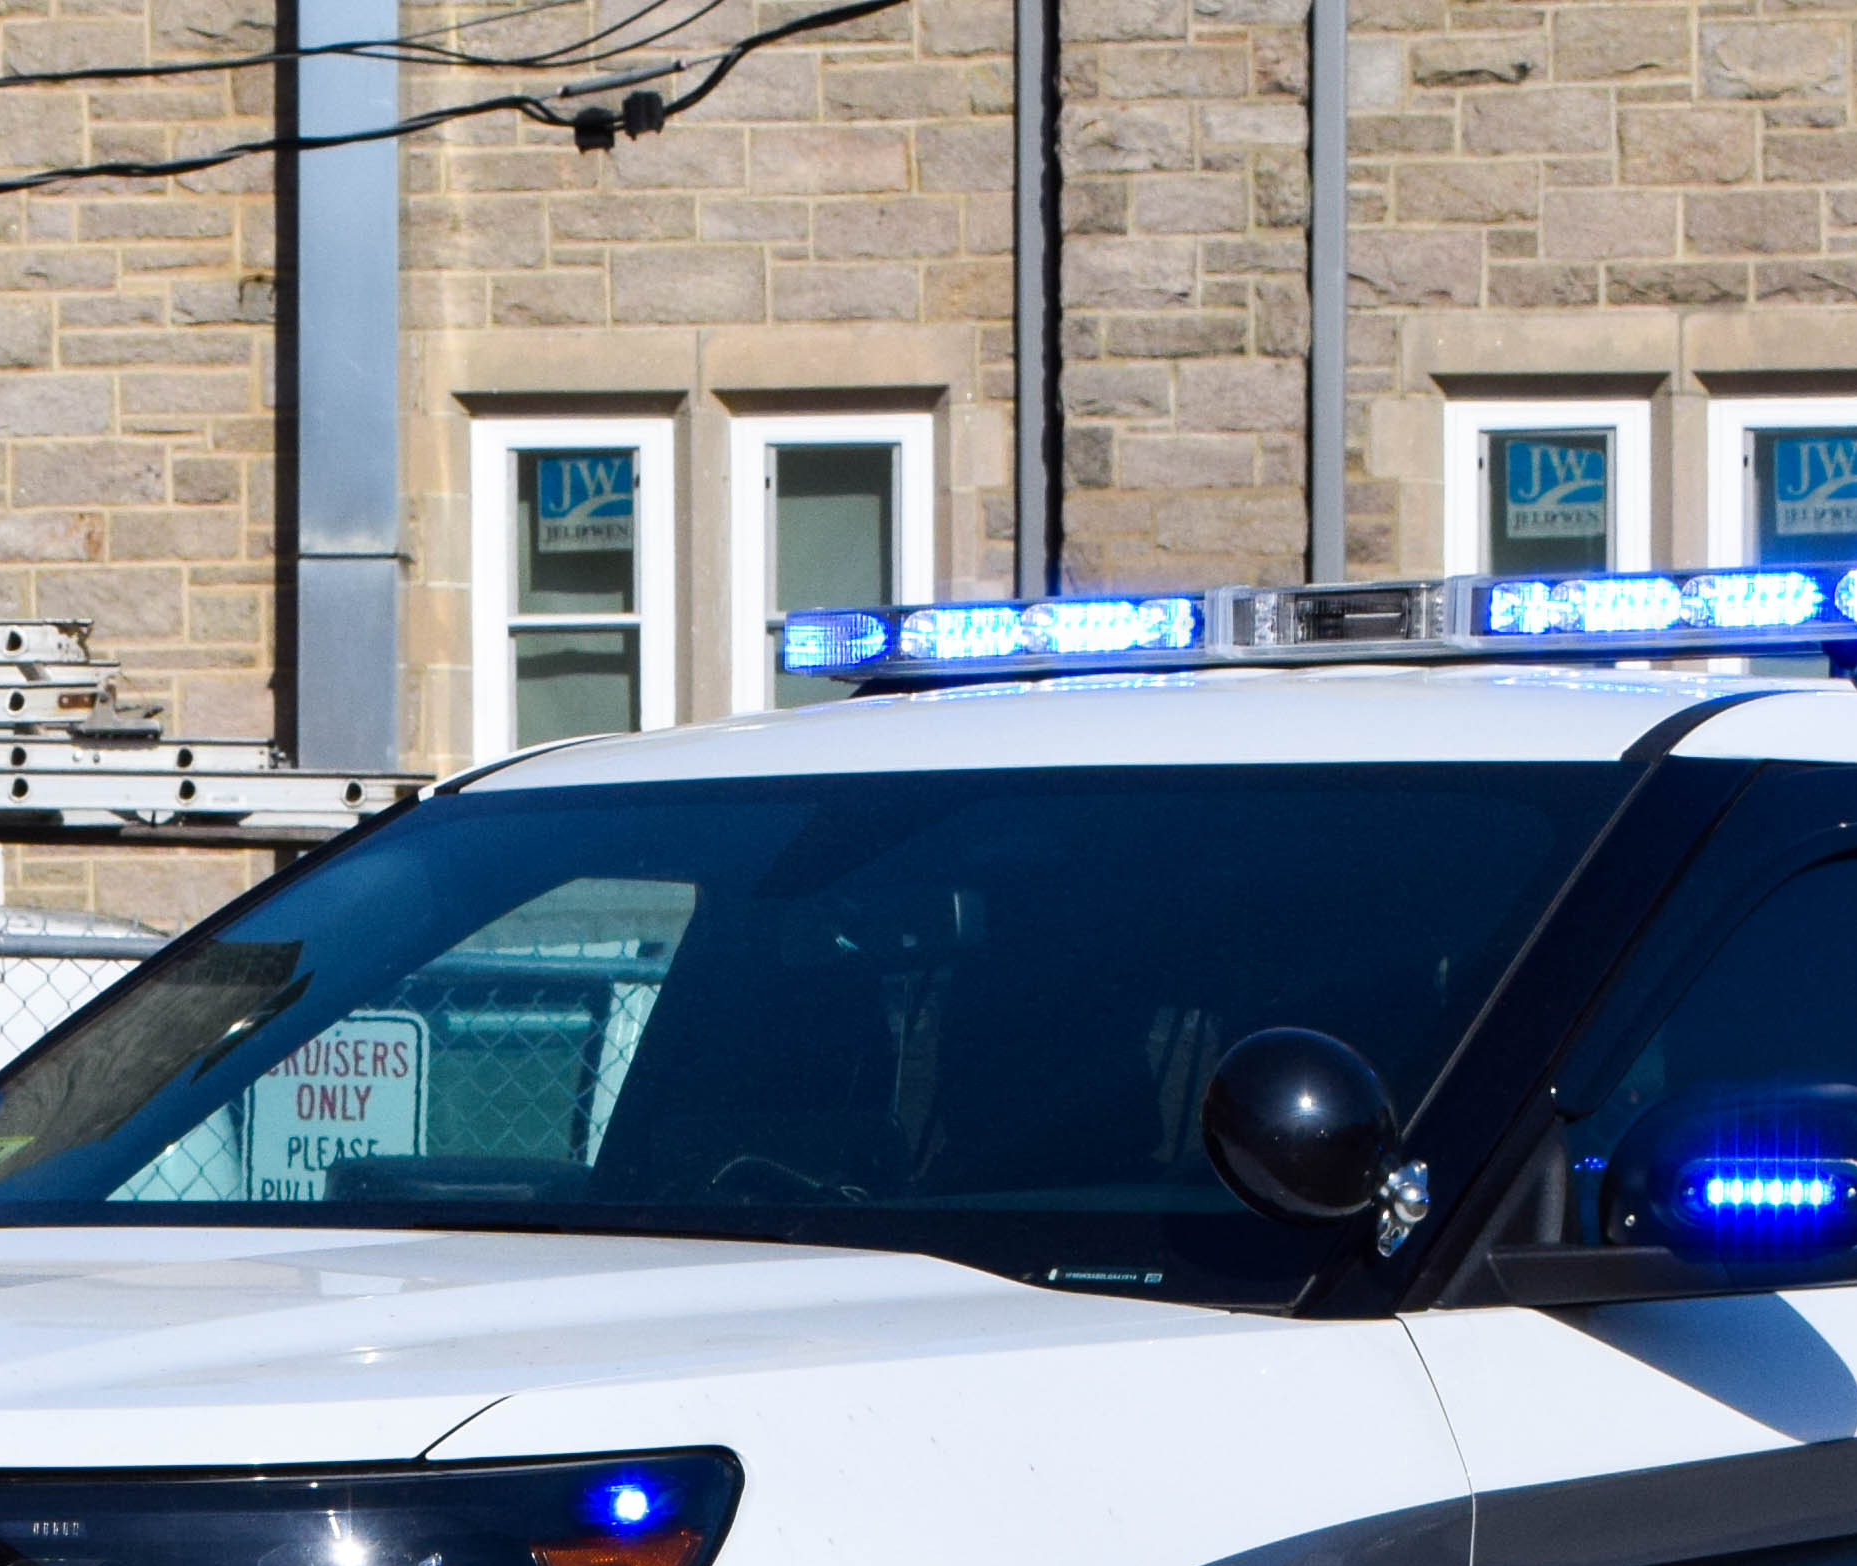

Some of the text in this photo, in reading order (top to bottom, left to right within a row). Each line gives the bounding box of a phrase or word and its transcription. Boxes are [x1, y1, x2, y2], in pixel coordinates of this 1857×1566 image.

[549, 460, 623, 512] JW
[1518, 447, 1590, 499] JW
[297, 1083, 372, 1121] ONLY
